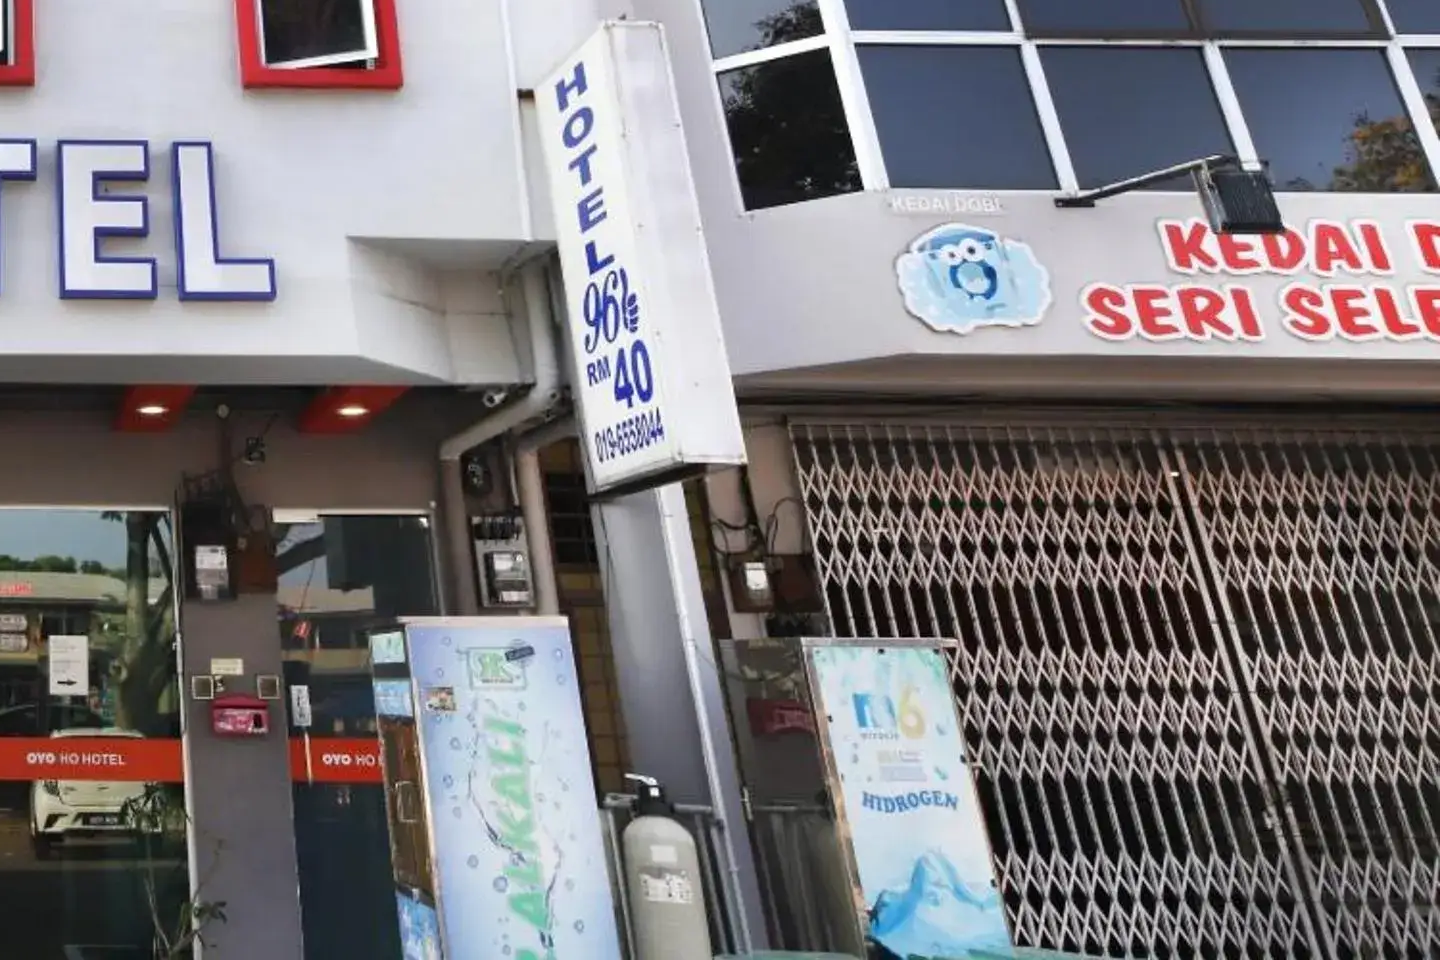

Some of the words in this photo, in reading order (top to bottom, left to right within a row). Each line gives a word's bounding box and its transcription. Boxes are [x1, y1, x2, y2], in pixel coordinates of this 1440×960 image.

[556, 61, 615, 275] HOTEL
[891, 196, 951, 214] KEDAI
[1162, 219, 1392, 273] KEDAI
[1084, 284, 1263, 338] SERI
[587, 355, 611, 387] RM
[614, 339, 653, 408] 40
[27, 752, 55, 766] OYO
[60, 752, 78, 766] HO
[82, 752, 125, 766] HOTEL
[322, 753, 351, 765] OYO
[355, 754, 375, 767] HO
[862, 790, 958, 814] HIDROGEN
